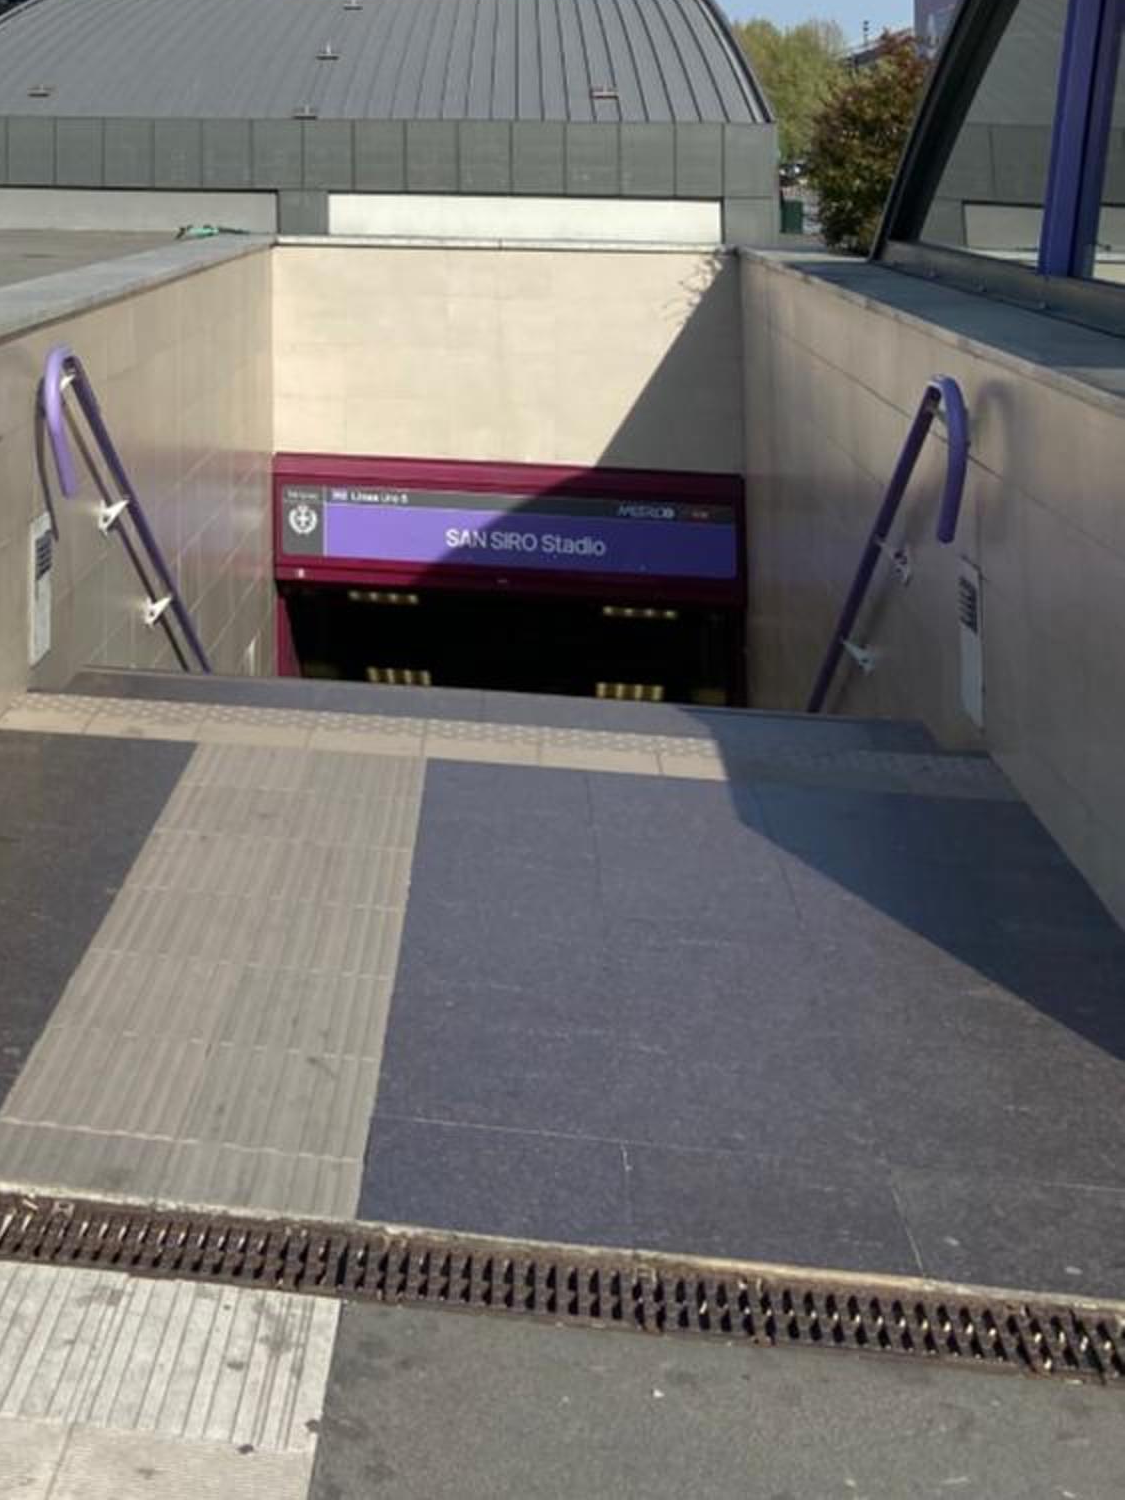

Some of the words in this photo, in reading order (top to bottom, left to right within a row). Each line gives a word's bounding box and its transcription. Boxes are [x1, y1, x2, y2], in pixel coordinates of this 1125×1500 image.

[445, 528, 488, 548] SAN
[490, 531, 538, 551] SIRO
[541, 534, 607, 556] Stadio
